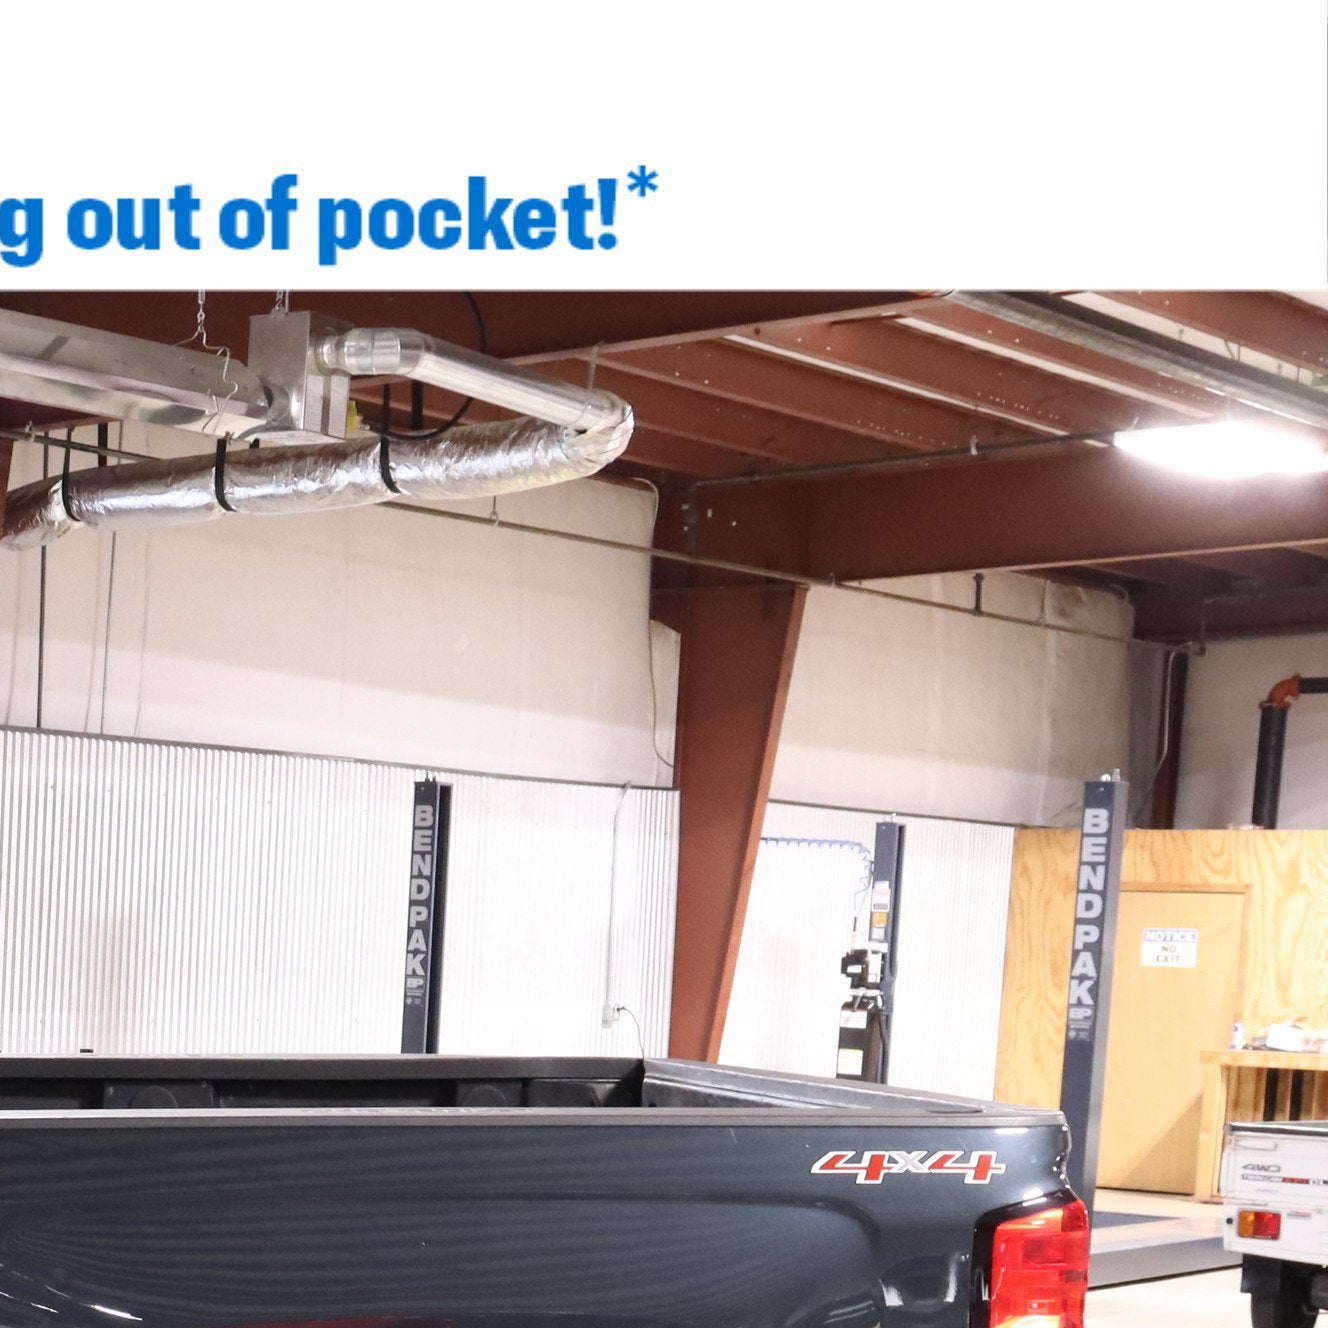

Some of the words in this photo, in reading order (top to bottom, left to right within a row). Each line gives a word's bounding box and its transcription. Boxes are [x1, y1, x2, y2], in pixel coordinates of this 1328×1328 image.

[406, 805, 434, 976] BENDPAK
[1069, 808, 1109, 1005] BENDPAK
[1145, 929, 1197, 942] NOTICE
[1161, 945, 1177, 953] NO
[1155, 954, 1180, 963] EXIT
[1242, 1163, 1282, 1174] 4WD
